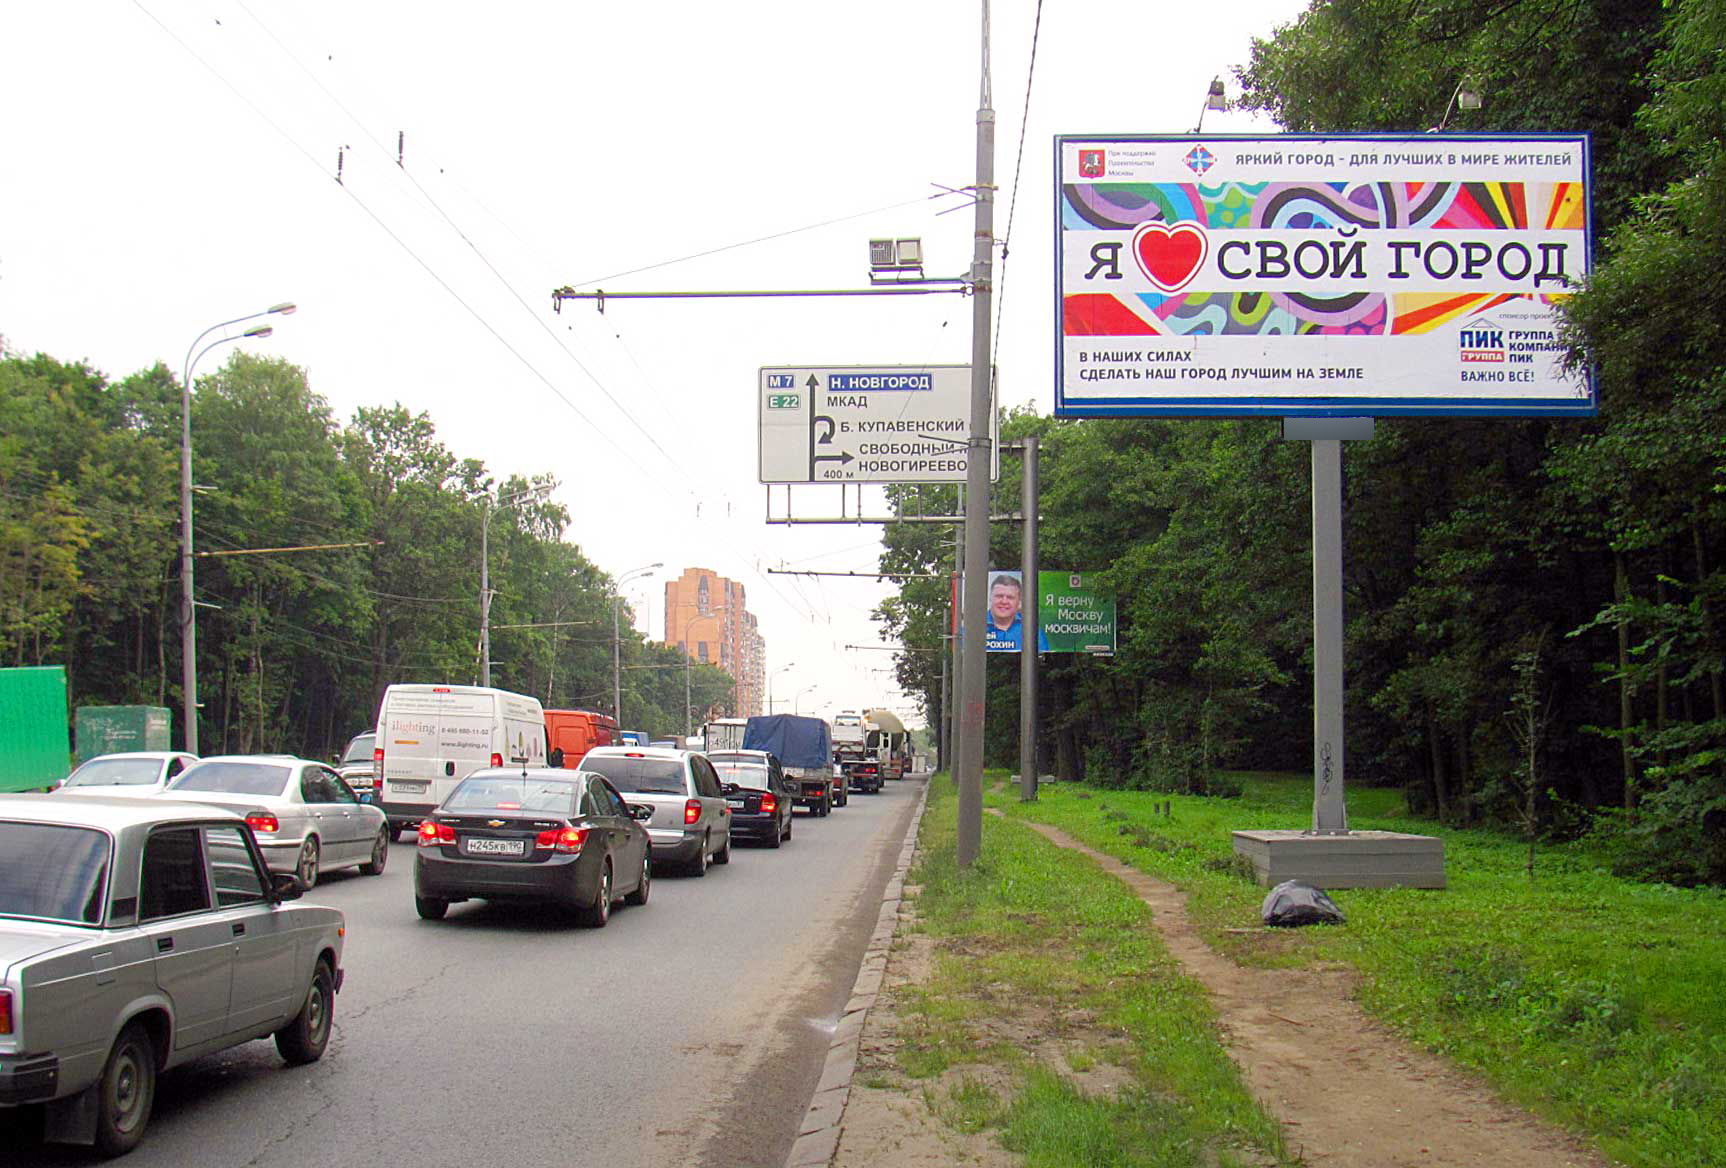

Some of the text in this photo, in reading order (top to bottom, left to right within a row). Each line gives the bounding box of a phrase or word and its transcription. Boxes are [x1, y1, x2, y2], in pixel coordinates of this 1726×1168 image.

[1235, 152, 1283, 165] ЯРКИЙ
[1288, 154, 1335, 167] ГОРОД
[1349, 154, 1378, 167] ДЛЯ
[1383, 154, 1443, 165] ЛУЧШИХ
[1448, 154, 1456, 165] В
[1461, 154, 1499, 165] МИРЕ
[1504, 152, 1571, 166] ЖИТЕЛЕЙ
[1084, 227, 1569, 288] Я СВОЙ ГОРОД
[1460, 331, 1504, 348] ПИК
[1509, 331, 1554, 340] ГРУППА
[1509, 343, 1568, 351] КОМПАНИ
[1079, 351, 1192, 362] В НАШИХ СИЛАХ
[1462, 352, 1503, 360] ГРУППА
[1509, 354, 1533, 363] ПИК
[1080, 368, 1364, 381] СДЕЛАТЬ НАШ ГОРОД ЛУЧШИМ НА ЗЕМЛЕ
[1461, 369, 1534, 382] ВАЖНО ВСЁ!
[769, 376, 793, 387] М 7
[831, 376, 929, 390] Н. НОВГОРОД
[783, 396, 798, 407] 22
[827, 396, 867, 408] МКАД
[841, 418, 964, 432] Б. КУПАВЕНСКИЙ
[859, 460, 967, 472] НОВОГИРЕЕВО
[824, 470, 842, 479] 400
[1045, 594, 1095, 609] Я верну
[1058, 609, 1104, 622] Москву
[1045, 623, 1111, 634] москвичам!
[392, 720, 436, 736] ilighting
